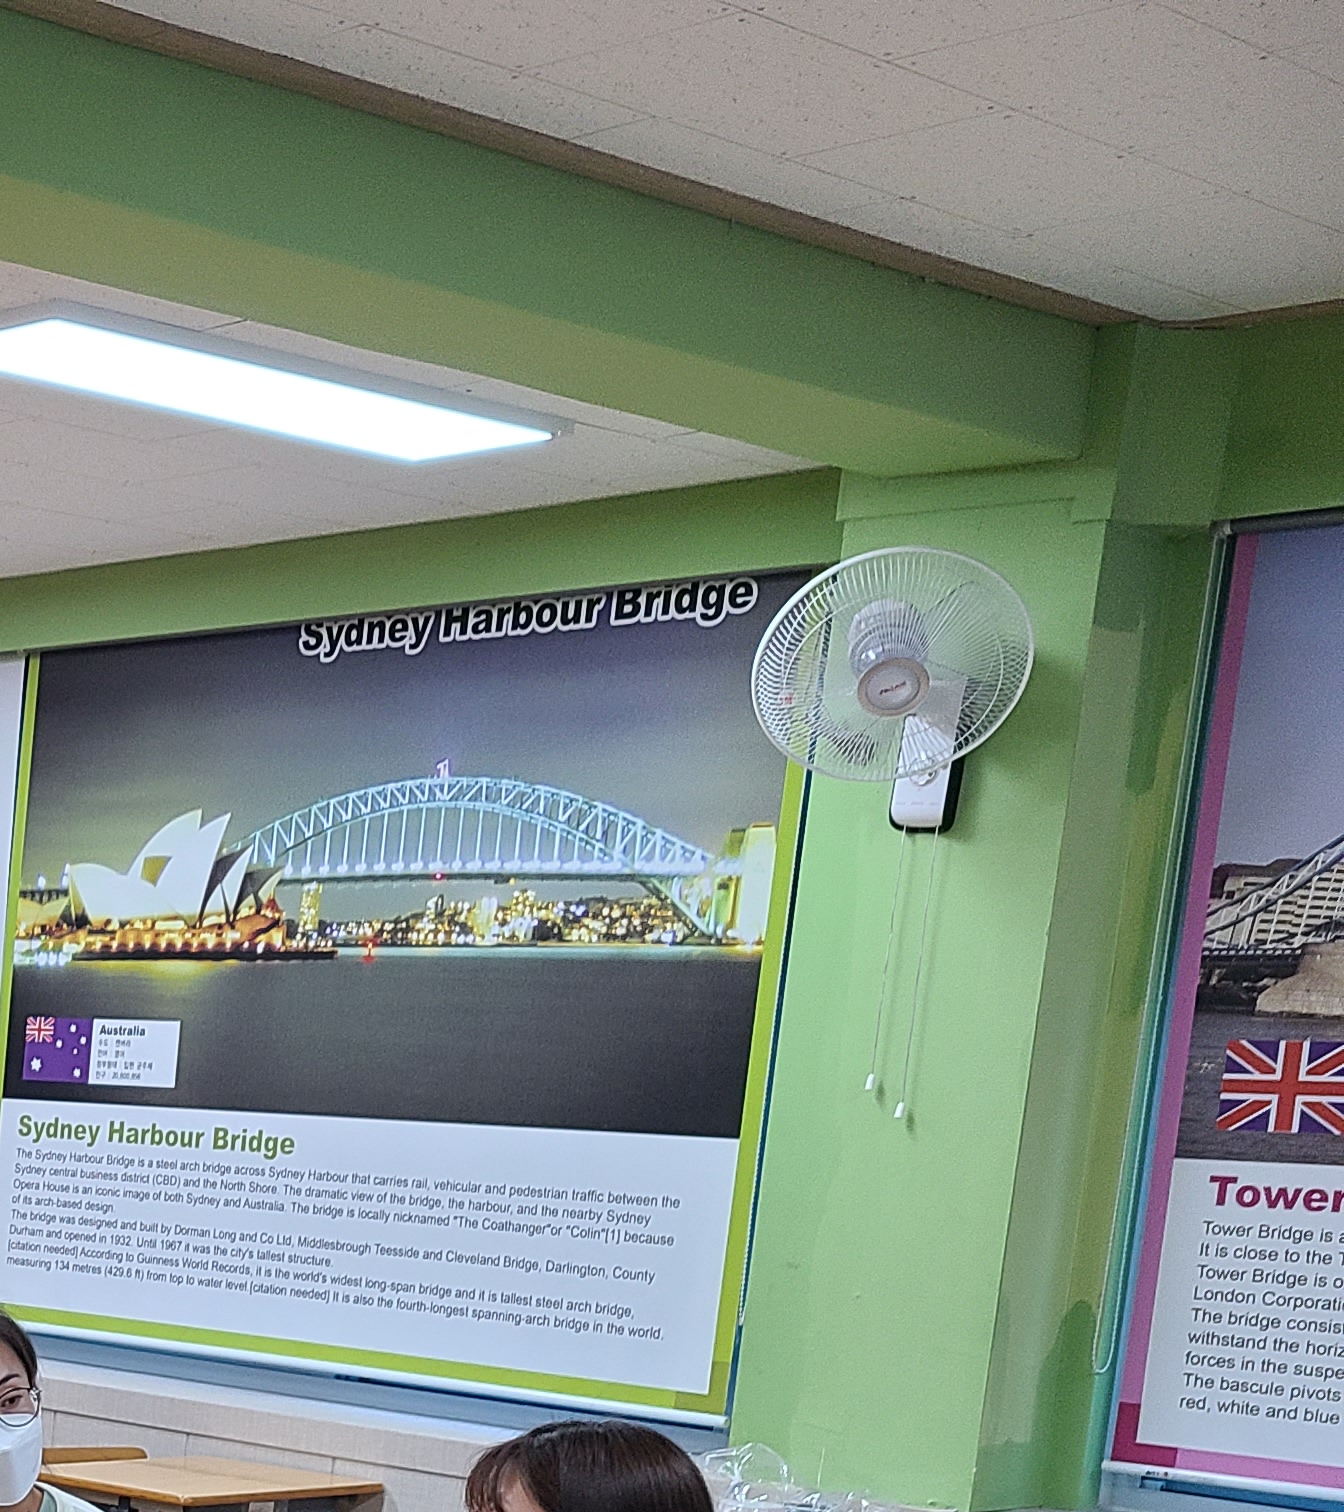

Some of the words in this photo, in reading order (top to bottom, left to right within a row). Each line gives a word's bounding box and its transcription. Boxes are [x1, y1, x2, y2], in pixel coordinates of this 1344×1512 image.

[299, 611, 436, 663] Sydney
[439, 592, 605, 642] Harbour
[610, 577, 758, 629] Bridge
[99, 1024, 146, 1037] Australia
[18, 1114, 100, 1147] Sydney
[108, 1120, 205, 1149] Harbour
[213, 1126, 296, 1160] Bridge
[16, 1147, 32, 1159] The
[34, 1149, 67, 1164] Sydney
[68, 1151, 104, 1164] Harbour
[106, 1154, 135, 1169] Bridge
[137, 1156, 144, 1167] is
[147, 1159, 153, 1168] a
[155, 1158, 177, 1169] steel
[179, 1160, 200, 1172] arch
[202, 1161, 231, 1176] bridge
[233, 1166, 265, 1176] across
[268, 1166, 305, 1182] Sydney
[307, 1168, 349, 1183] Harbour
[351, 1172, 370, 1185] that
[373, 1175, 408, 1187] carries
[411, 1177, 429, 1191] rail,
[433, 1179, 481, 1193] vehicular
[484, 1183, 506, 1195] and
[508, 1184, 568, 1200] pedestrian
[571, 1188, 604, 1202] traffic
[607, 1190, 657, 1206] between
[661, 1194, 680, 1208] the
[11, 1193, 21, 1203] of
[22, 1195, 32, 1205] its
[34, 1196, 82, 1209] arch-based
[14, 1163, 47, 1178] Sydney
[48, 1167, 78, 1177] central
[79, 1168, 118, 1181] business
[120, 1171, 150, 1184] district
[152, 1173, 180, 1188] (CBD)
[182, 1177, 200, 1188] and
[202, 1177, 217, 1189] the
[219, 1179, 246, 1192] North
[282, 1183, 302, 1196] The
[304, 1185, 348, 1200] dramatic
[350, 1189, 374, 1202] view
[376, 1191, 387, 1203] of
[389, 1192, 405, 1205] the
[408, 1193, 444, 1210] bridge,
[447, 1196, 464, 1209] the
[467, 1198, 513, 1215] harbour,
[516, 1203, 538, 1215] and
[540, 1204, 558, 1217] the
[561, 1207, 603, 1223] nearby
[605, 1209, 651, 1227] Sydney
[1209, 1175, 1344, 1213] Tower
[12, 1178, 40, 1191] Opera
[42, 1180, 70, 1193] House
[71, 1183, 79, 1194] is
[81, 1186, 92, 1195] an
[94, 1185, 120, 1197] iconic
[122, 1187, 150, 1202] image
[152, 1190, 162, 1201] of
[163, 1190, 183, 1202] both
[186, 1192, 221, 1209] Sydney
[222, 1196, 241, 1208] and
[242, 1197, 286, 1211] Australia.
[290, 1201, 309, 1214] The
[312, 1202, 343, 1219] bridge
[346, 1206, 355, 1218] is
[357, 1206, 390, 1223] locally
[392, 1210, 450, 1226] nicknamed
[623, 1229, 674, 1245] because
[11, 1208, 27, 1220] The
[29, 1210, 56, 1225] bridge
[58, 1215, 75, 1225] was
[77, 1215, 118, 1230] designed
[119, 1220, 137, 1231] and
[139, 1220, 158, 1233] built
[160, 1222, 172, 1237] by
[173, 1223, 210, 1238] Dorman
[212, 1227, 236, 1243] Long
[238, 1231, 257, 1242] and
[259, 1231, 274, 1244] Co
[276, 1233, 294, 1248] Ltd,
[297, 1235, 371, 1256] Middlesbrough
[373, 1243, 419, 1258] Teesside
[422, 1249, 442, 1261] and
[445, 1249, 500, 1266] Cleveland
[503, 1255, 541, 1273] Bridge,
[545, 1259, 608, 1280] Darlington,
[612, 1265, 655, 1284] County
[1203, 1220, 1254, 1238] Tower
[1258, 1224, 1314, 1244] Bridge
[1319, 1228, 1333, 1243] is
[1199, 1242, 1210, 1257] It
[1214, 1243, 1228, 1258] is
[1233, 1245, 1279, 1261] close
[1284, 1248, 1300, 1263] to
[1306, 1250, 1333, 1265] the
[1197, 1264, 1248, 1281] Tower
[1252, 1268, 1308, 1289] Bridge
[1313, 1273, 1328, 1288] is
[1193, 1285, 1256, 1304] London
[1262, 1291, 1344, 1312] Corporati
[1191, 1307, 1223, 1324] The
[1227, 1311, 1282, 1331] bridge
[1286, 1318, 1344, 1335] consis
[1188, 1331, 1268, 1350] withstand
[1273, 1337, 1300, 1353] the
[1185, 1350, 1236, 1369] forces
[1240, 1355, 1255, 1372] in
[1261, 1358, 1288, 1374] the
[1293, 1363, 1344, 1382] suspe
[1183, 1372, 1215, 1389] The
[1220, 1376, 1285, 1396] bascule
[1289, 1384, 1342, 1402] pivots
[1179, 1396, 1211, 1413] red,
[1217, 1399, 1260, 1416] white
[1265, 1405, 1298, 1420] and
[1303, 1408, 1340, 1425] blue
